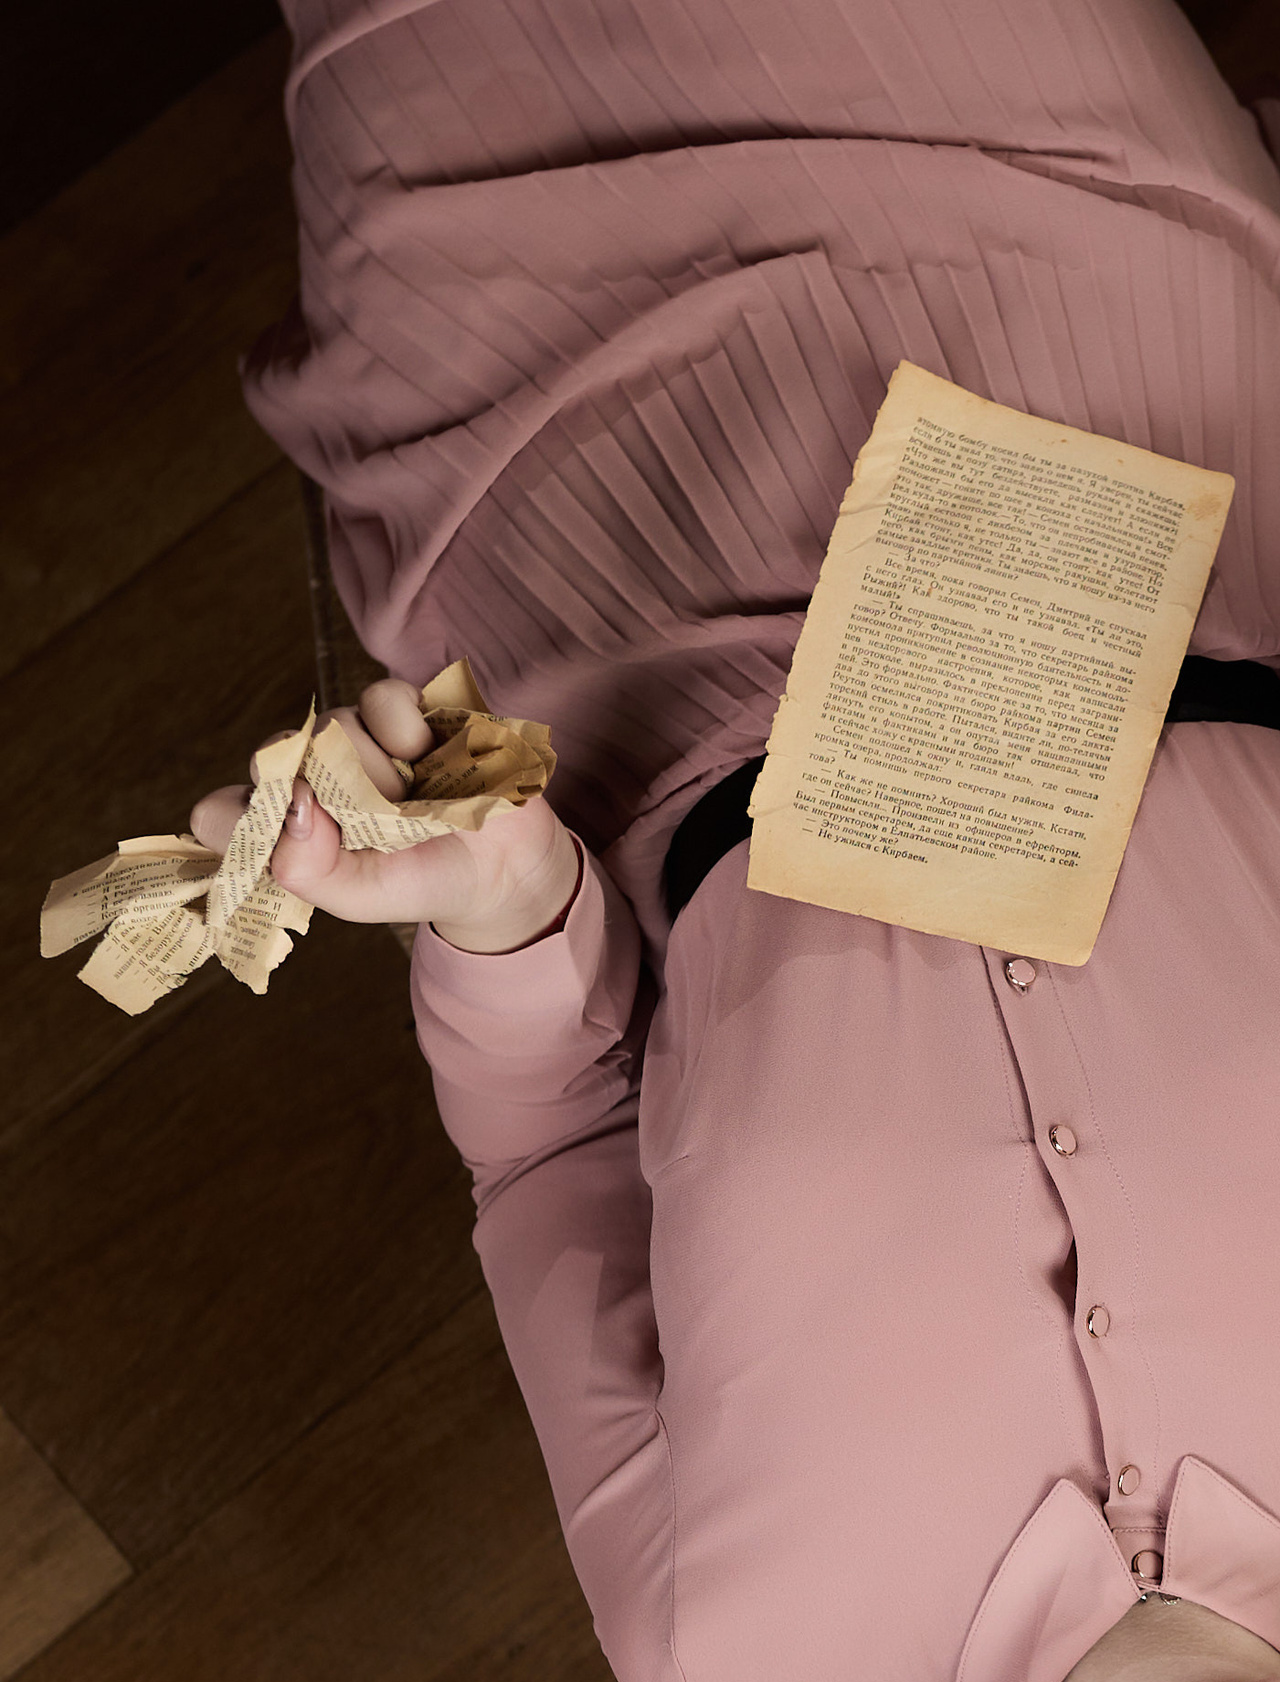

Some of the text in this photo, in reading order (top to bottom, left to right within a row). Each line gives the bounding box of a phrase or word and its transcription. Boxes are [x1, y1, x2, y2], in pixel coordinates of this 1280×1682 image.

[807, 752, 836, 764] това?
[813, 732, 942, 771] кромка озера, продолжал:
[831, 724, 863, 740] Семен
[868, 736, 911, 753] подошел
[926, 752, 951, 765] окну
[955, 760, 963, 769] и,
[969, 764, 998, 776] глядя
[1002, 771, 1033, 786] вдаль,
[1039, 781, 1058, 791] где
[1064, 787, 1099, 800] синела
[801, 772, 1034, 836] где он сейчас? Наверное, пошел на повышение?
[836, 768, 856, 781] Как
[859, 777, 873, 785] же
[876, 781, 888, 789] не
[890, 785, 937, 801] помнить?
[939, 795, 985, 813] Хороший
[987, 807, 1007, 819] был
[1010, 815, 1045, 829] мужик.
[1049, 823, 1086, 841] Кстати,
[843, 749, 857, 760] Ты
[862, 757, 908, 774] помнишь
[913, 770, 952, 784] первого
[956, 781, 1006, 798] секретаря
[1011, 795, 1054, 810] райкома
[1062, 804, 1093, 818] Фила-
[791, 802, 809, 811] час
[811, 807, 879, 830] инструктором
[889, 826, 958, 849] Елпатьевском
[960, 845, 997, 860] районе.
[795, 790, 816, 803] Был
[818, 799, 855, 813] первым
[857, 809, 915, 831] секретарем,
[917, 825, 931, 834] да
[932, 829, 953, 839] еще
[955, 834, 986, 846] каким
[988, 842, 1045, 863] секретарем,
[1057, 859, 1078, 867] сей-
[817, 828, 832, 839] Не
[833, 835, 871, 849] ужился
[881, 845, 927, 864] Кирбаем.
[820, 818, 840, 830] Это
[841, 826, 877, 842] почему
[879, 836, 899, 845] же?
[891, 805, 944, 825] Произвели
[964, 824, 1012, 841] офицеров
[1024, 839, 1080, 859] ефрейторы.
[102, 908, 129, 920] Когда
[136, 936, 154, 956] голос
